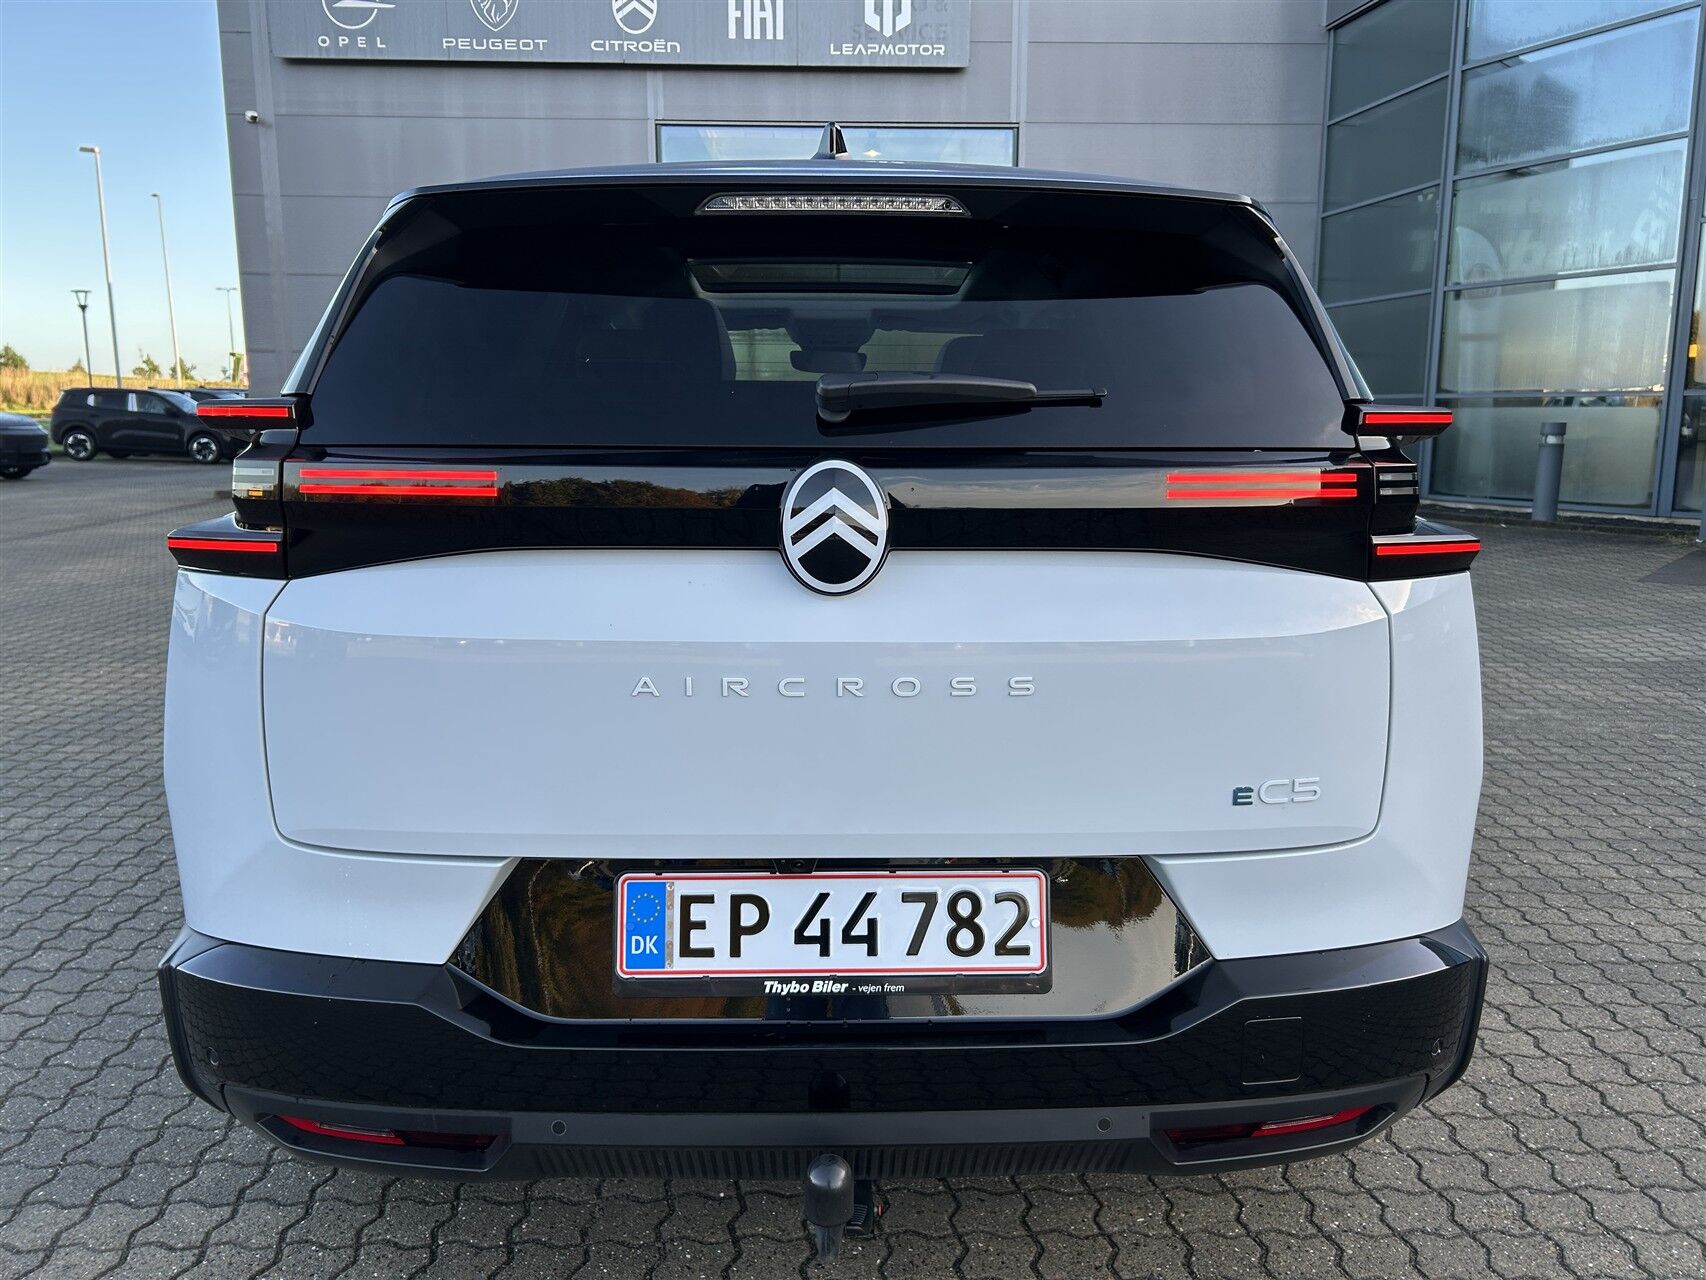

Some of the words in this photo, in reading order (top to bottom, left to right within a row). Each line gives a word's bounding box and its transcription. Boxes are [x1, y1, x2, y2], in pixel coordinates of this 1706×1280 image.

[318, 35, 386, 48] OPEL
[442, 38, 548, 50] PEUGEOT
[590, 39, 681, 53] CITROËN
[830, 43, 946, 56] LEAPMOTOR
[631, 676, 1036, 697] AIRCROSS
[678, 893, 770, 958] EP
[793, 892, 878, 958] 44
[901, 889, 1031, 957] 782
[631, 935, 658, 955] DK
[763, 980, 810, 995] Thybo
[812, 980, 849, 993] Biler
[858, 984, 882, 994] vejen
[884, 982, 905, 993] frem
